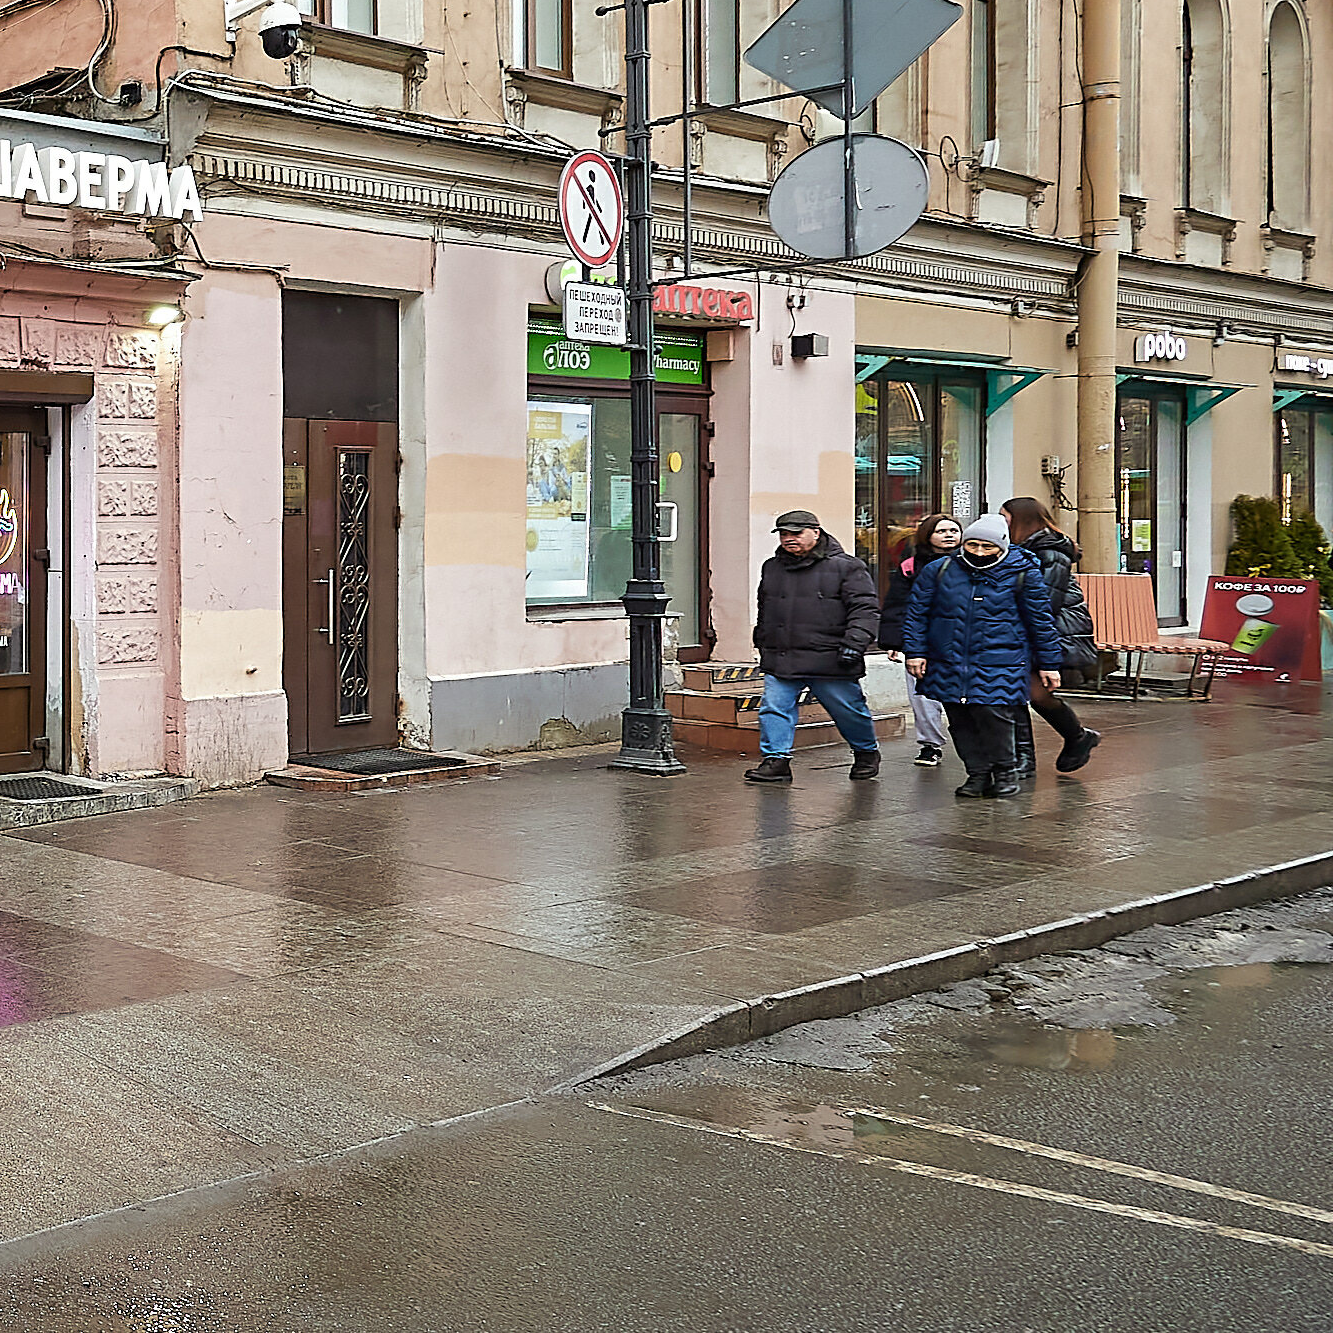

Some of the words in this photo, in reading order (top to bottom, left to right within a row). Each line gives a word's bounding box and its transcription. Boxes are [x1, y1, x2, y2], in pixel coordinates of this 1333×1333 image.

[569, 289, 622, 306] ПЕШЕХОДНЫЙ
[579, 306, 614, 322] ПЕРЕХОД
[574, 321, 619, 337] ЗАПРЕЩЕН!
[653, 354, 700, 375] harmacy
[1214, 582, 1252, 592] КОФЕ
[1253, 584, 1271, 592] ЗА
